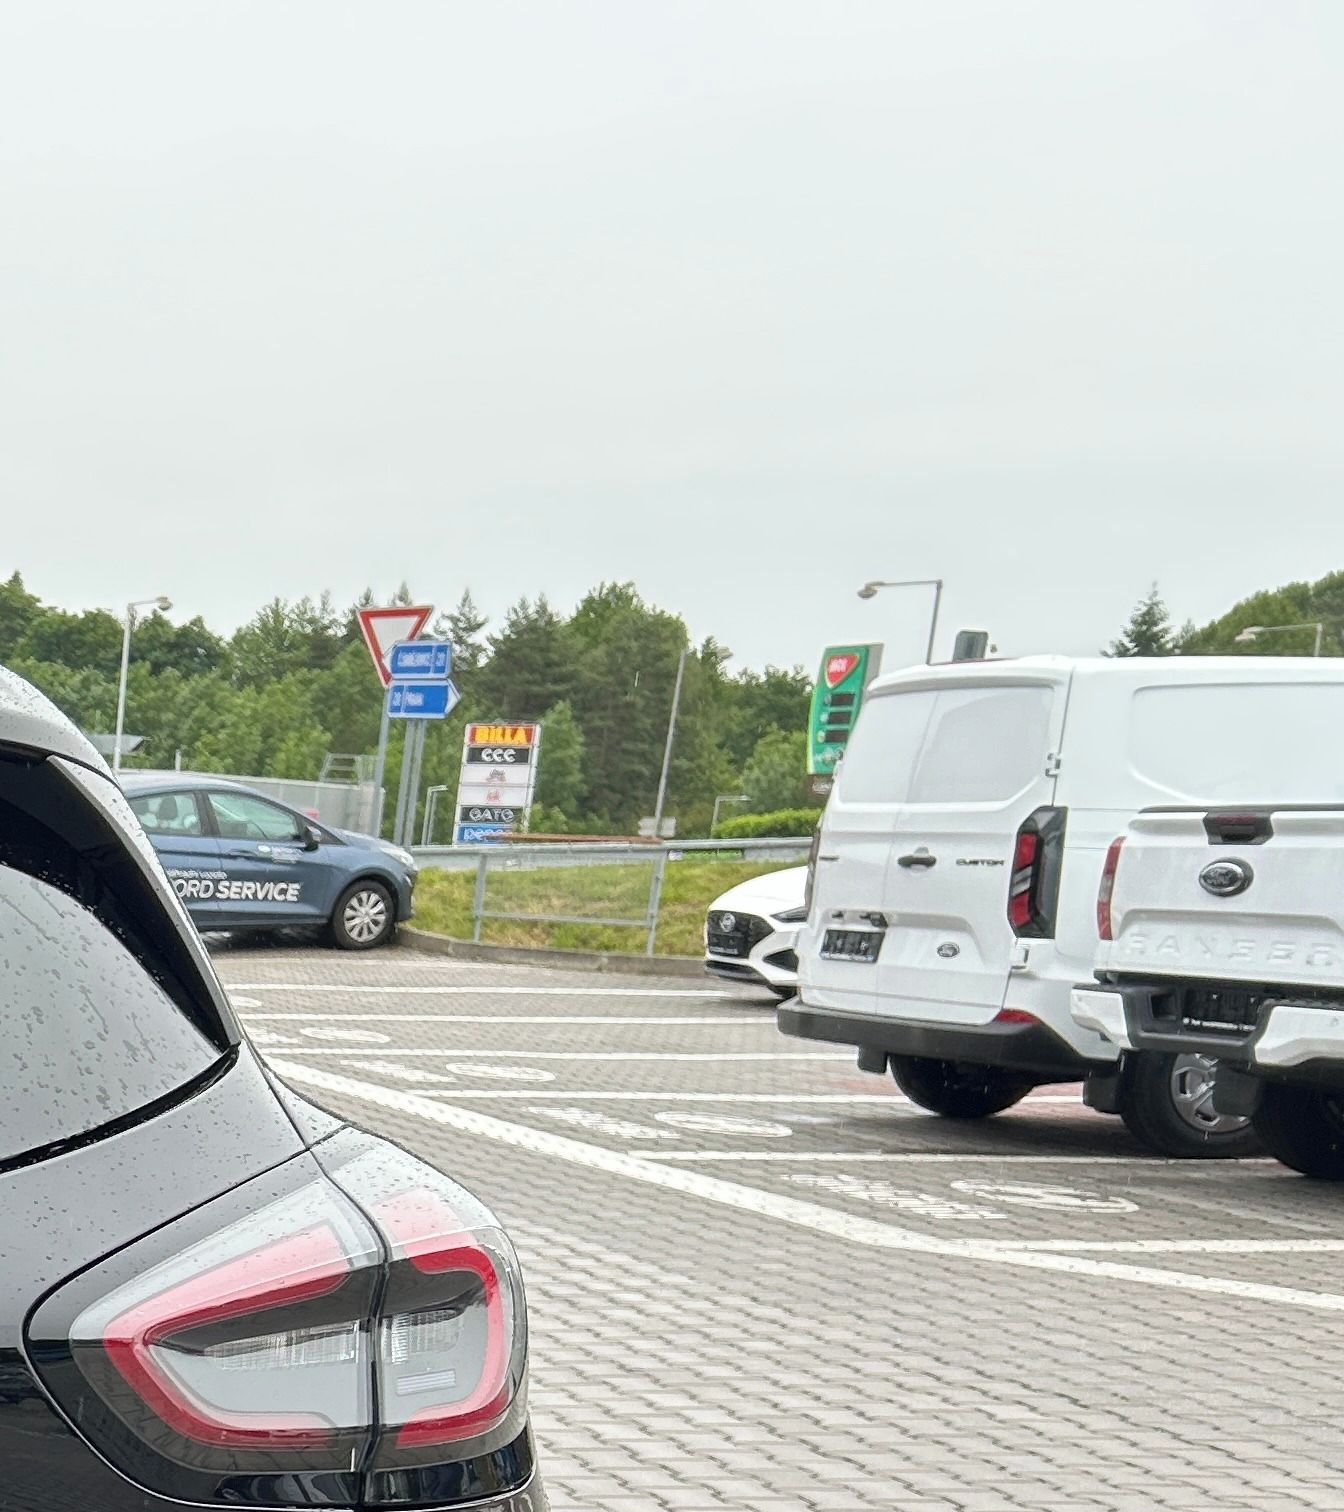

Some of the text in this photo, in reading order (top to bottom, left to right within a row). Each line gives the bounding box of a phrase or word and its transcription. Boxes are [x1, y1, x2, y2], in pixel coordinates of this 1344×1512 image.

[475, 726, 529, 745] BILLA
[173, 878, 302, 902] ORD SERVICE
